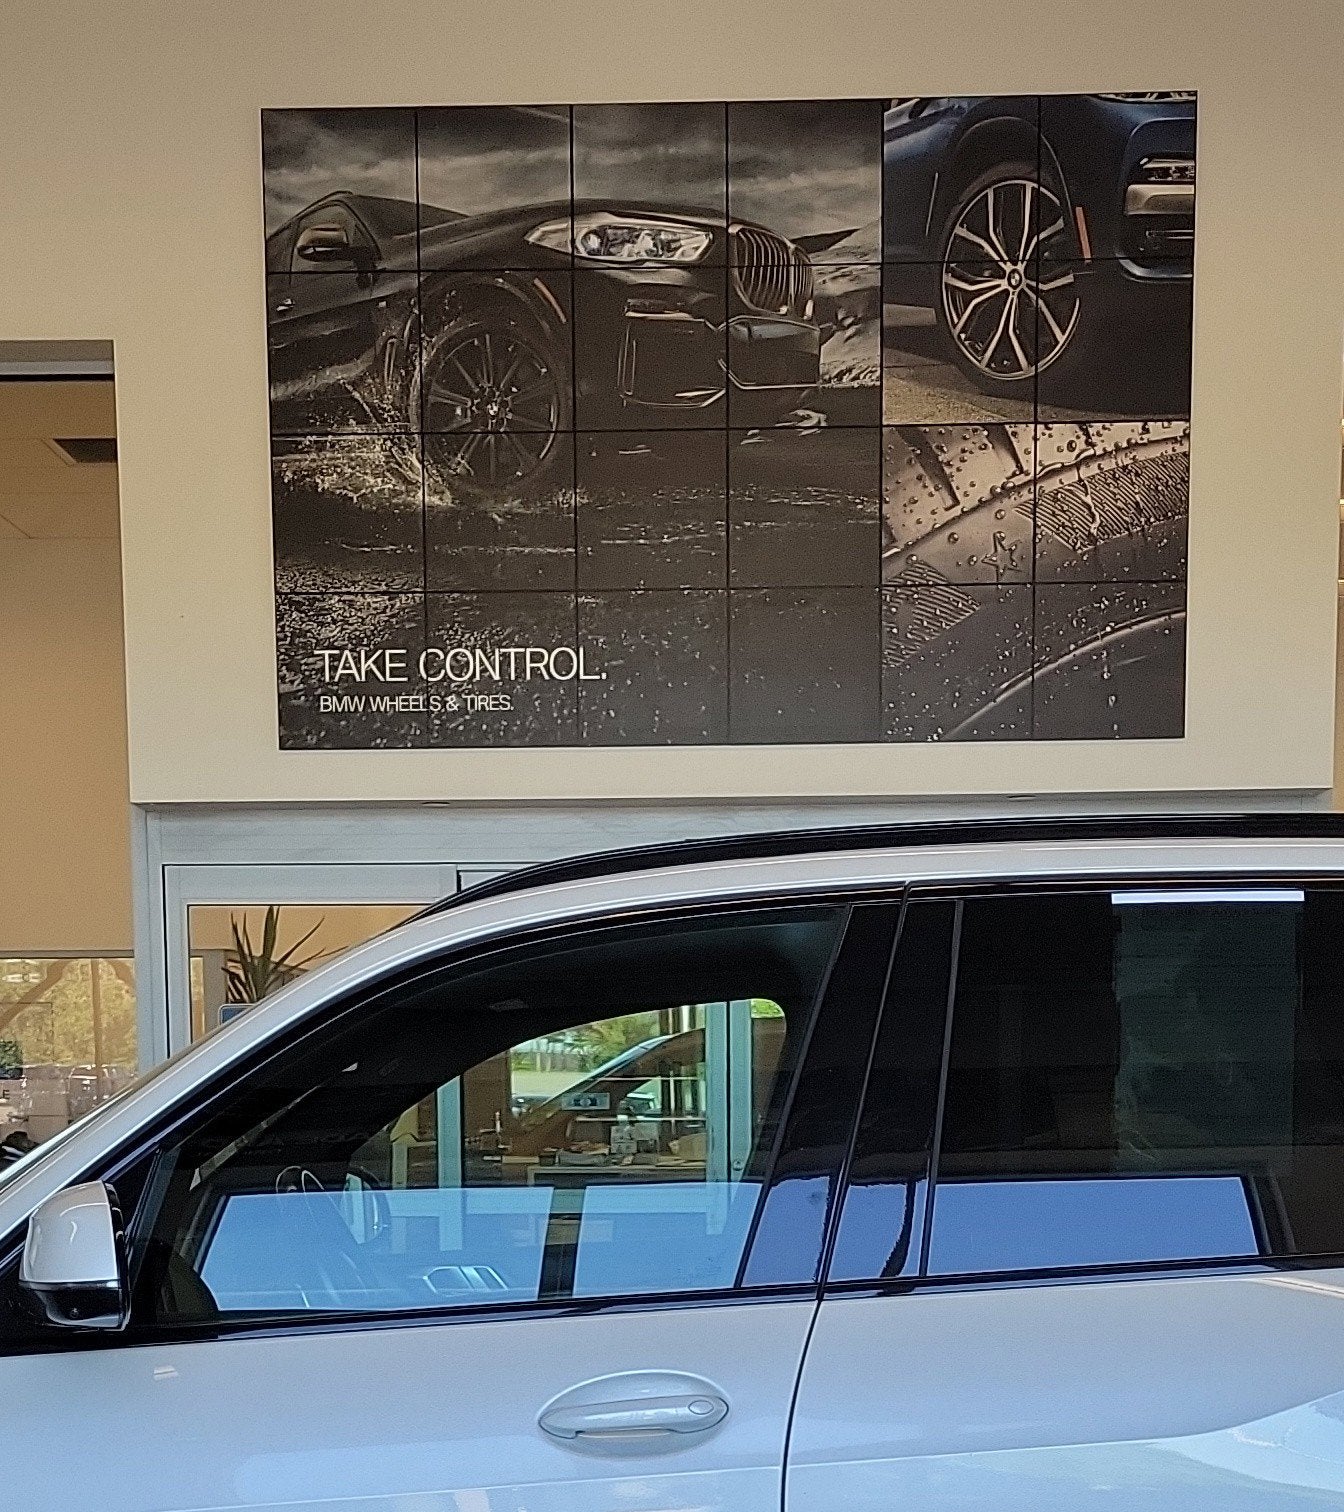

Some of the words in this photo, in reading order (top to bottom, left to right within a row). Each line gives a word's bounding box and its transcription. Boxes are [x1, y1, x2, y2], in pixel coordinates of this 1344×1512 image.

[314, 648, 409, 683] TAKE
[419, 646, 607, 682] CONTROL.
[319, 696, 366, 712] BMW
[369, 696, 442, 713] WHEELS
[445, 695, 459, 712] &
[463, 695, 515, 712] TIRES.
